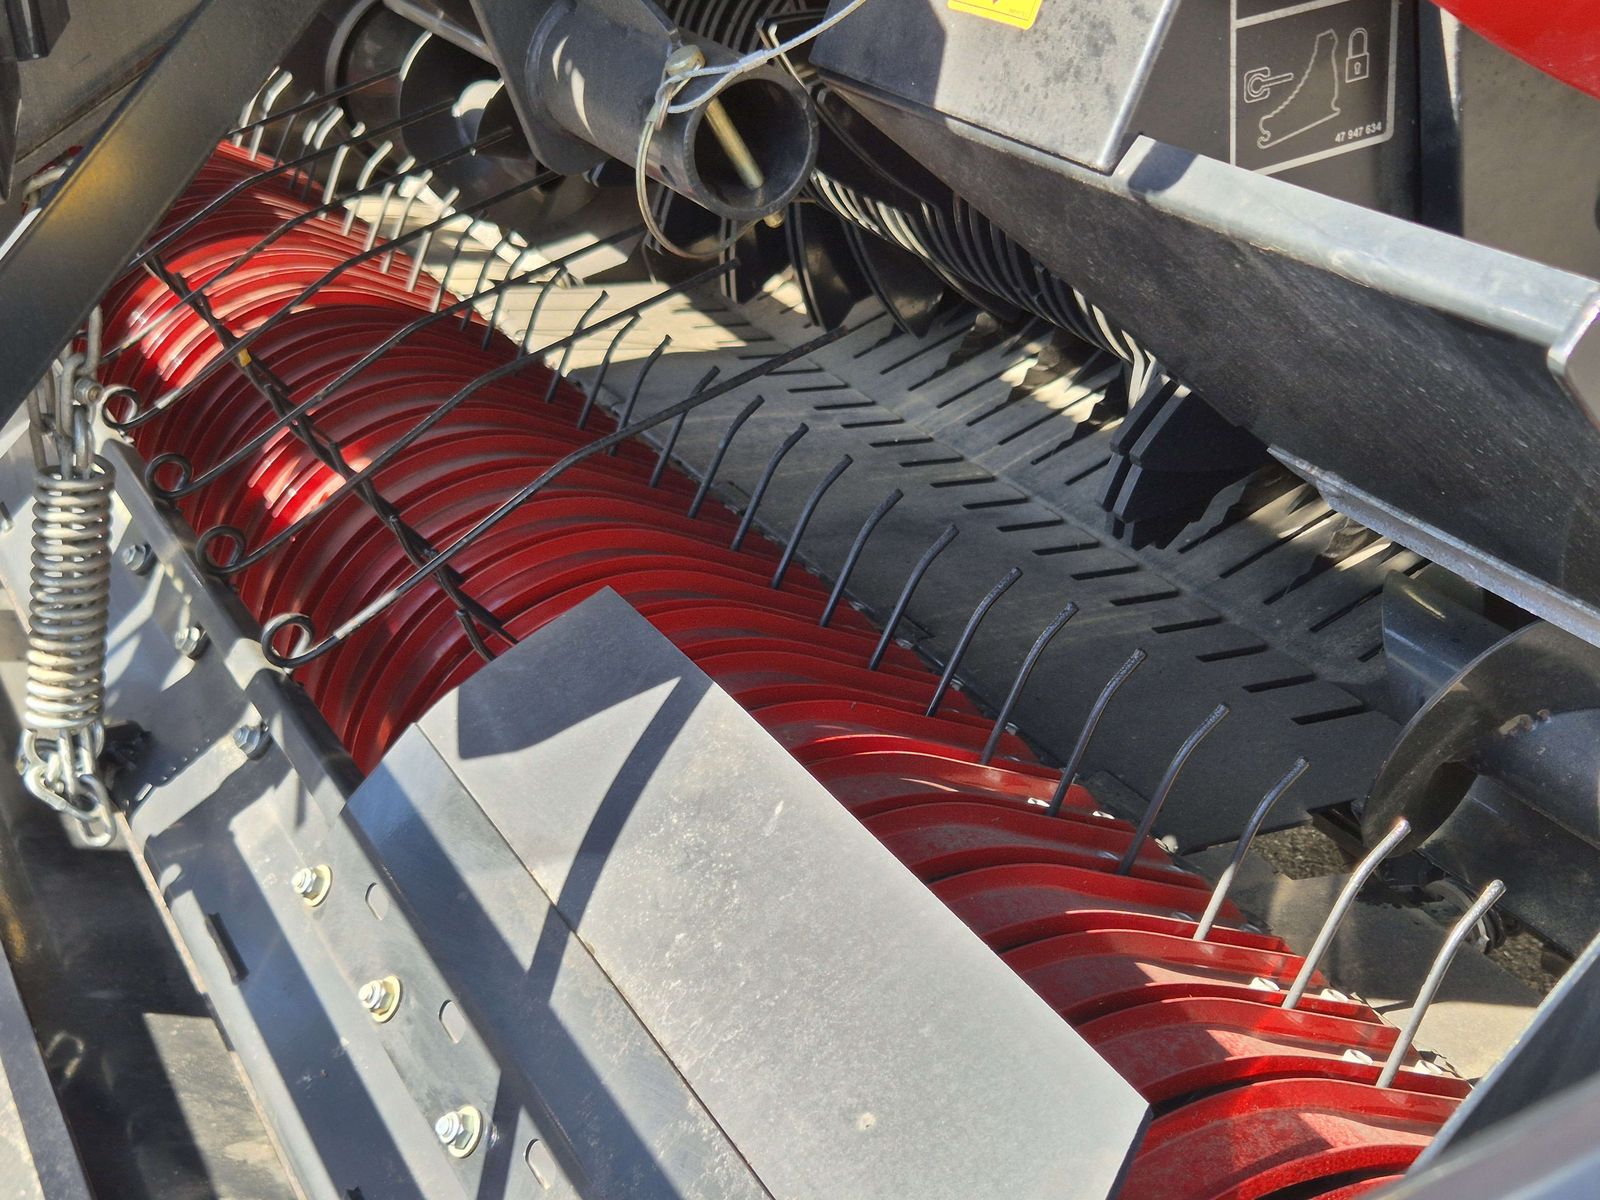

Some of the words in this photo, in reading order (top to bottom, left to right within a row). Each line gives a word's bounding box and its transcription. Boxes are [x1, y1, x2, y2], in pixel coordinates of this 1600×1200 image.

[1335, 131, 1346, 142] 47
[1347, 126, 1364, 140] 947
[1365, 121, 1382, 135] 634
